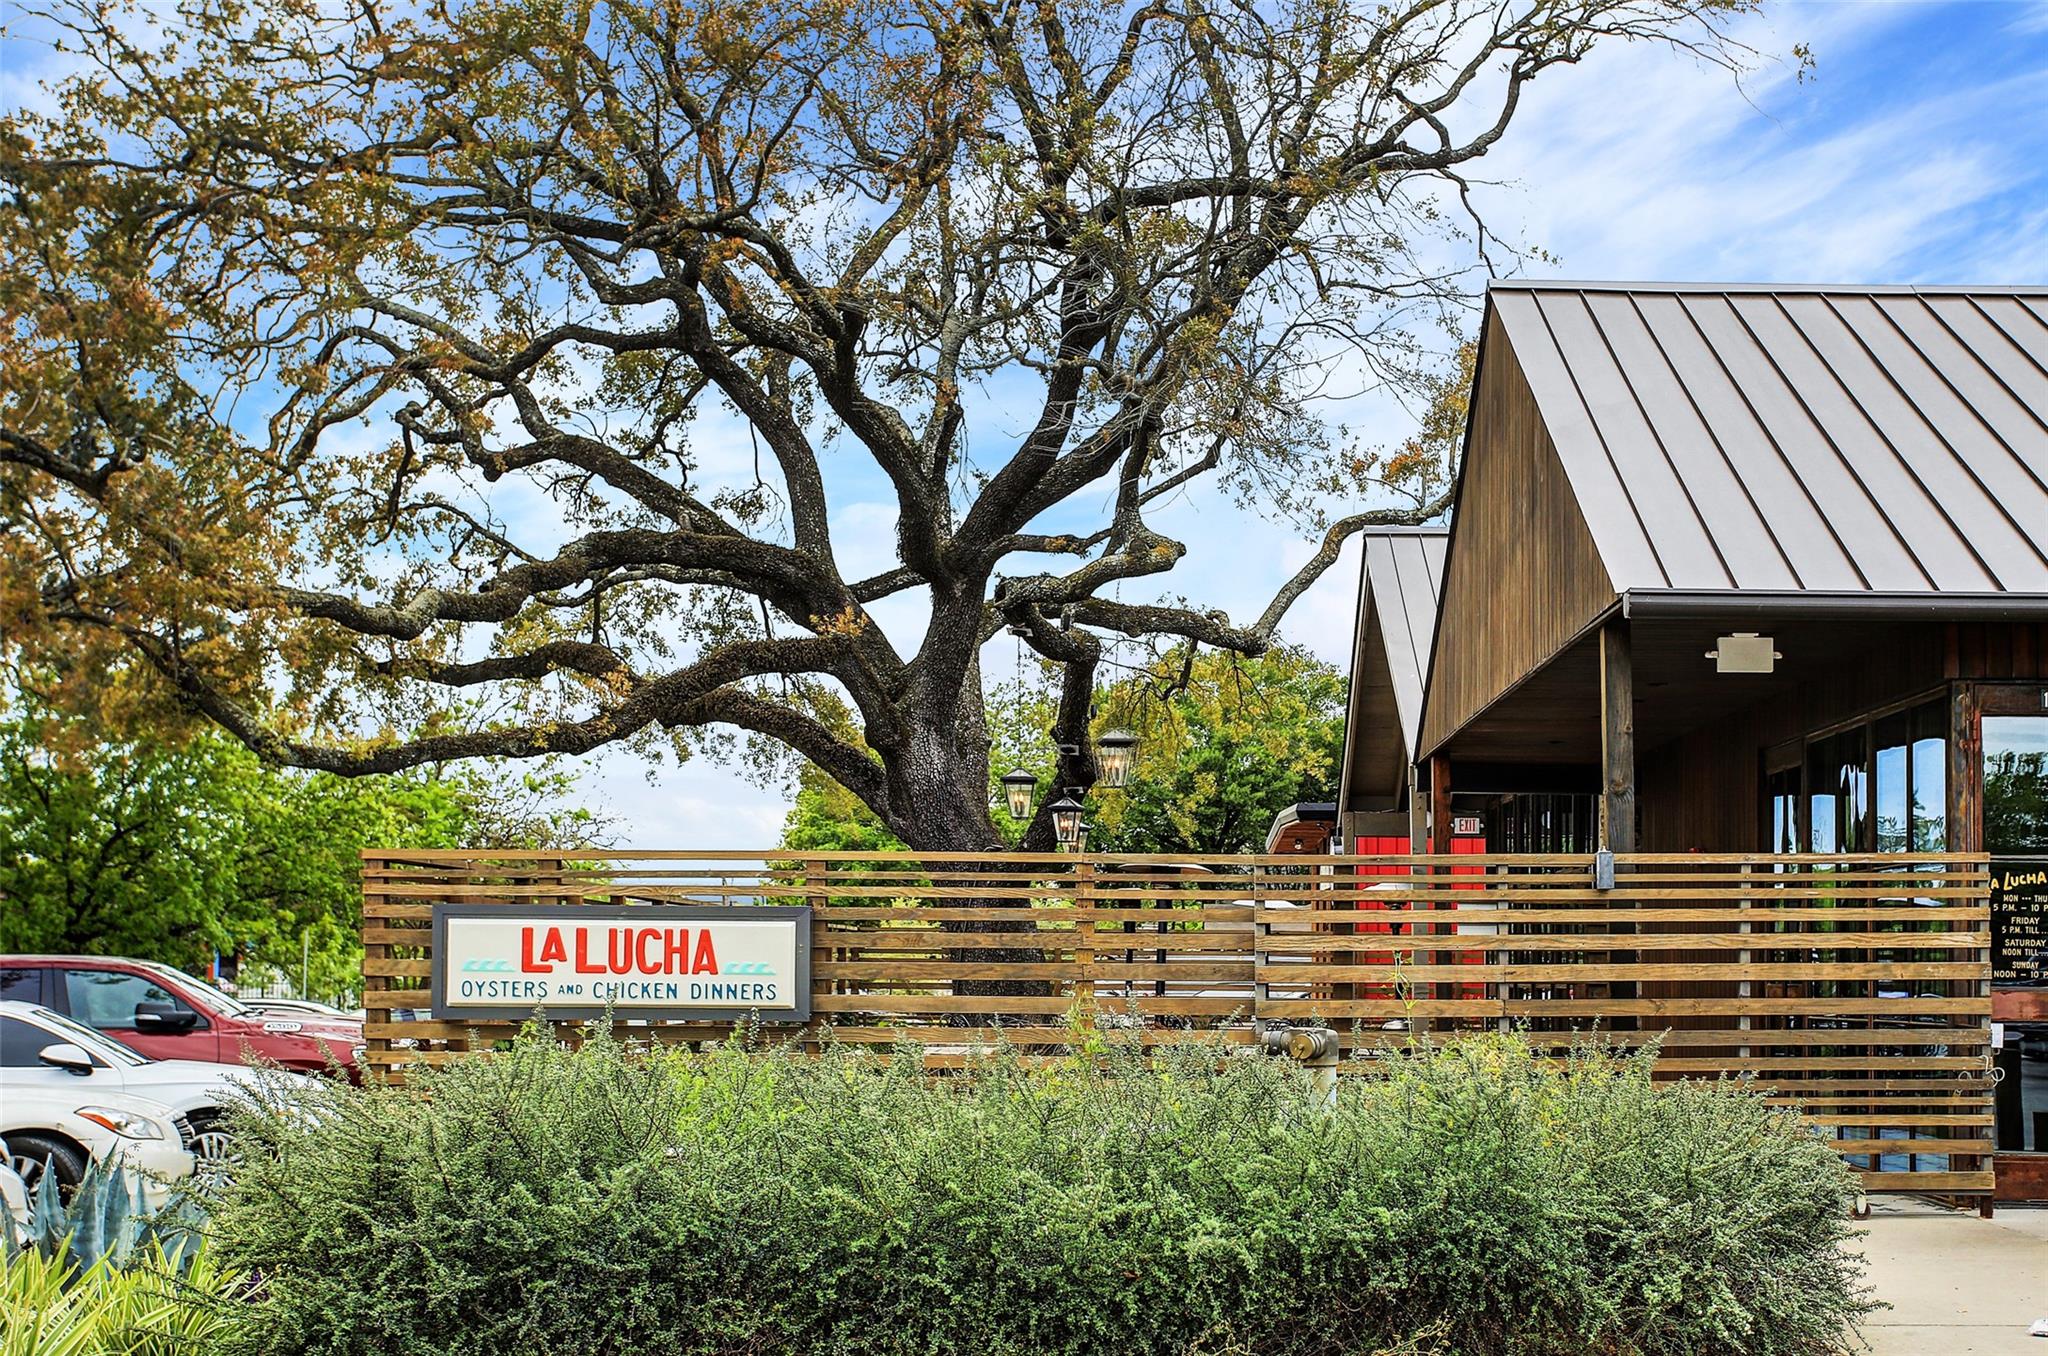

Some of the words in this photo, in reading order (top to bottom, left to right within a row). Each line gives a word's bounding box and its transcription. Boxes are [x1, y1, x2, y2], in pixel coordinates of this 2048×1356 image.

[1459, 819, 1476, 832] EXIT
[2003, 871, 2048, 891] LUCHA
[2003, 894, 2019, 902] MON
[1993, 903, 1999, 912] 5
[2002, 903, 2018, 912] P.M.
[2031, 904, 2040, 912] 10
[2011, 916, 2040, 925] FRIDAY
[2001, 925, 2007, 934] 5
[2004, 939, 2047, 947] SATURDAY
[521, 927, 567, 974] LA
[575, 927, 719, 976] LUCHA
[2002, 948, 2022, 956] NOON
[2012, 961, 2039, 969] SUNDAY
[1993, 970, 2017, 978] NOON
[2030, 970, 2039, 979] 10
[461, 980, 549, 999] OYSTERS
[558, 985, 583, 996] AND
[592, 981, 679, 1000] CHICKEN
[690, 982, 778, 1001] DINNERS
